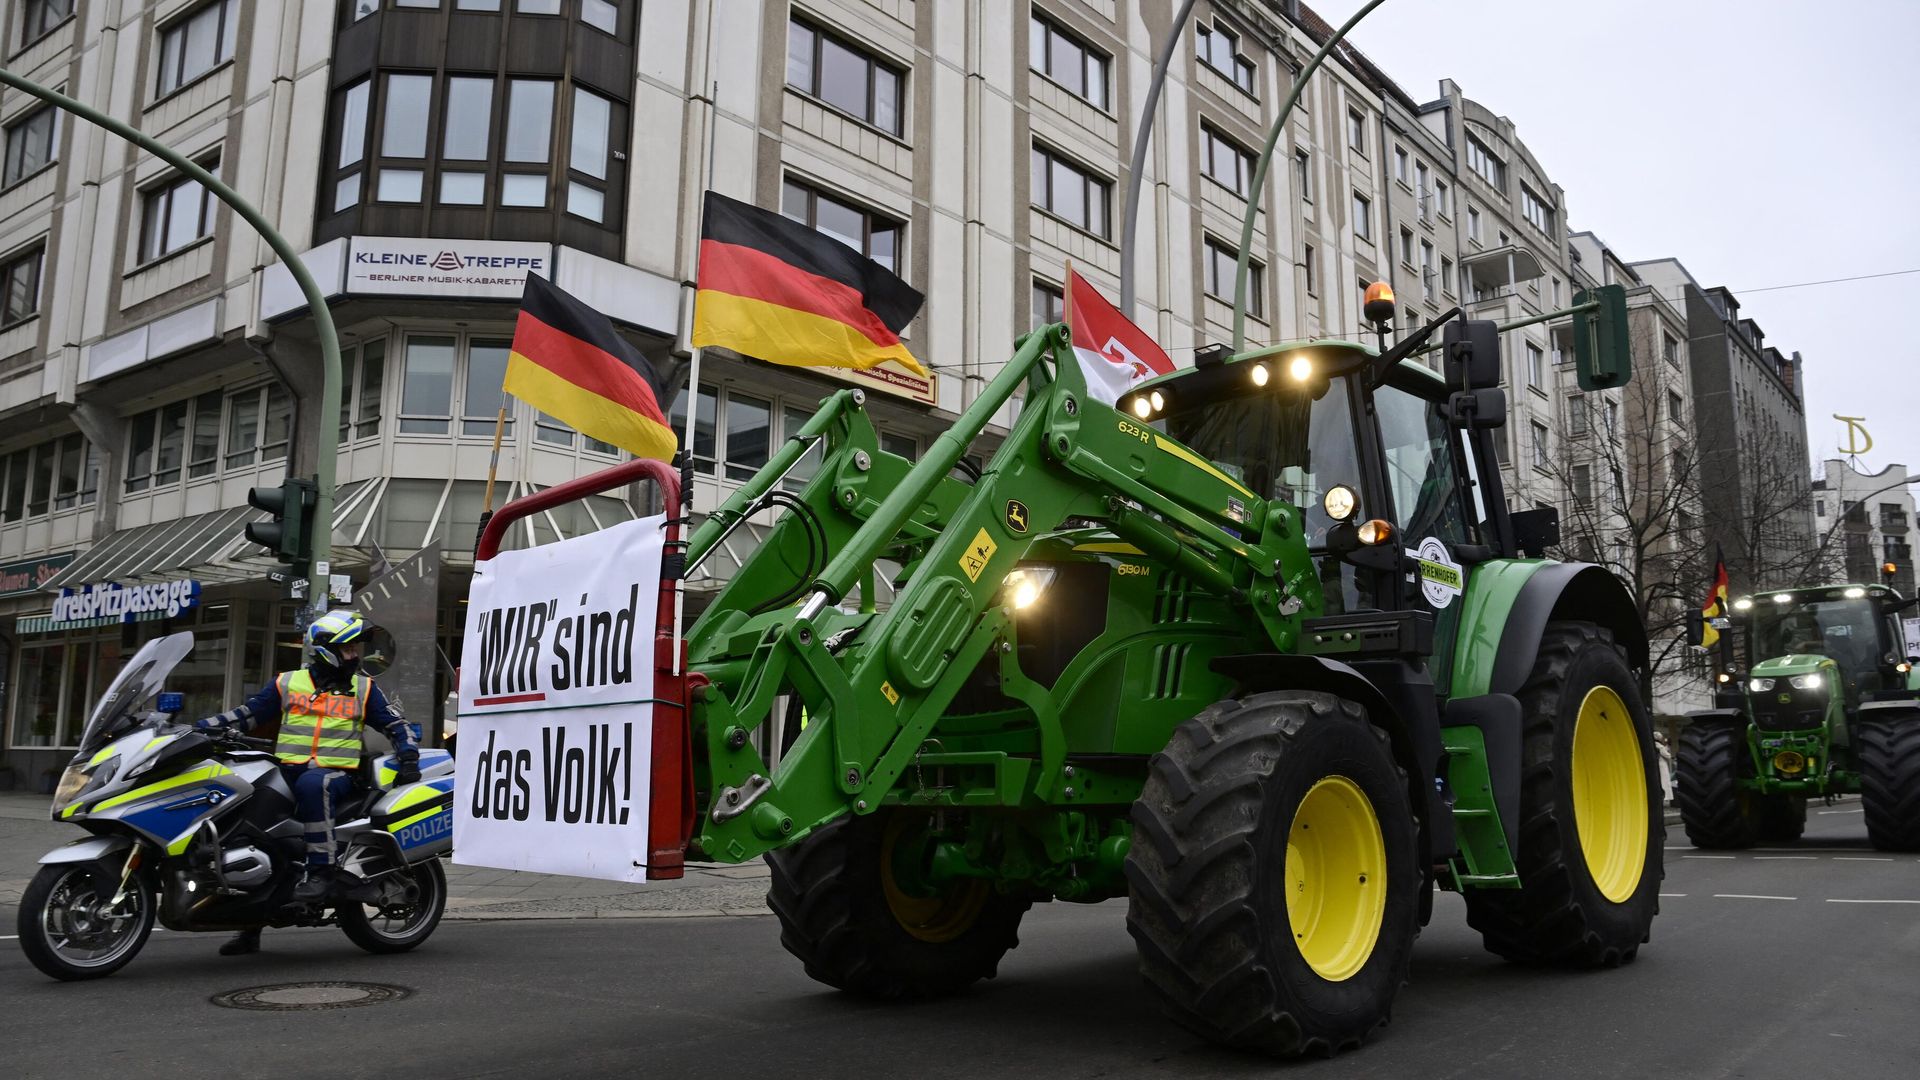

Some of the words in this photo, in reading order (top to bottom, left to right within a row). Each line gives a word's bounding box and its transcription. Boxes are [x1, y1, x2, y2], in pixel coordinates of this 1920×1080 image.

[355, 252, 428, 265] KLEINE
[463, 256, 543, 269] TREPPE
[369, 274, 424, 282] BERLINER
[428, 276, 526, 285] MUSIK-KABARETT
[1118, 421, 1140, 437] 623
[1140, 431, 1149, 444] R
[360, 556, 432, 611] PITZ
[1421, 563, 1458, 585] RRENHOFER
[551, 583, 639, 691] sind
[471, 729, 532, 822] das
[542, 722, 633, 825] Volk!
[400, 814, 453, 846] POLIZE
